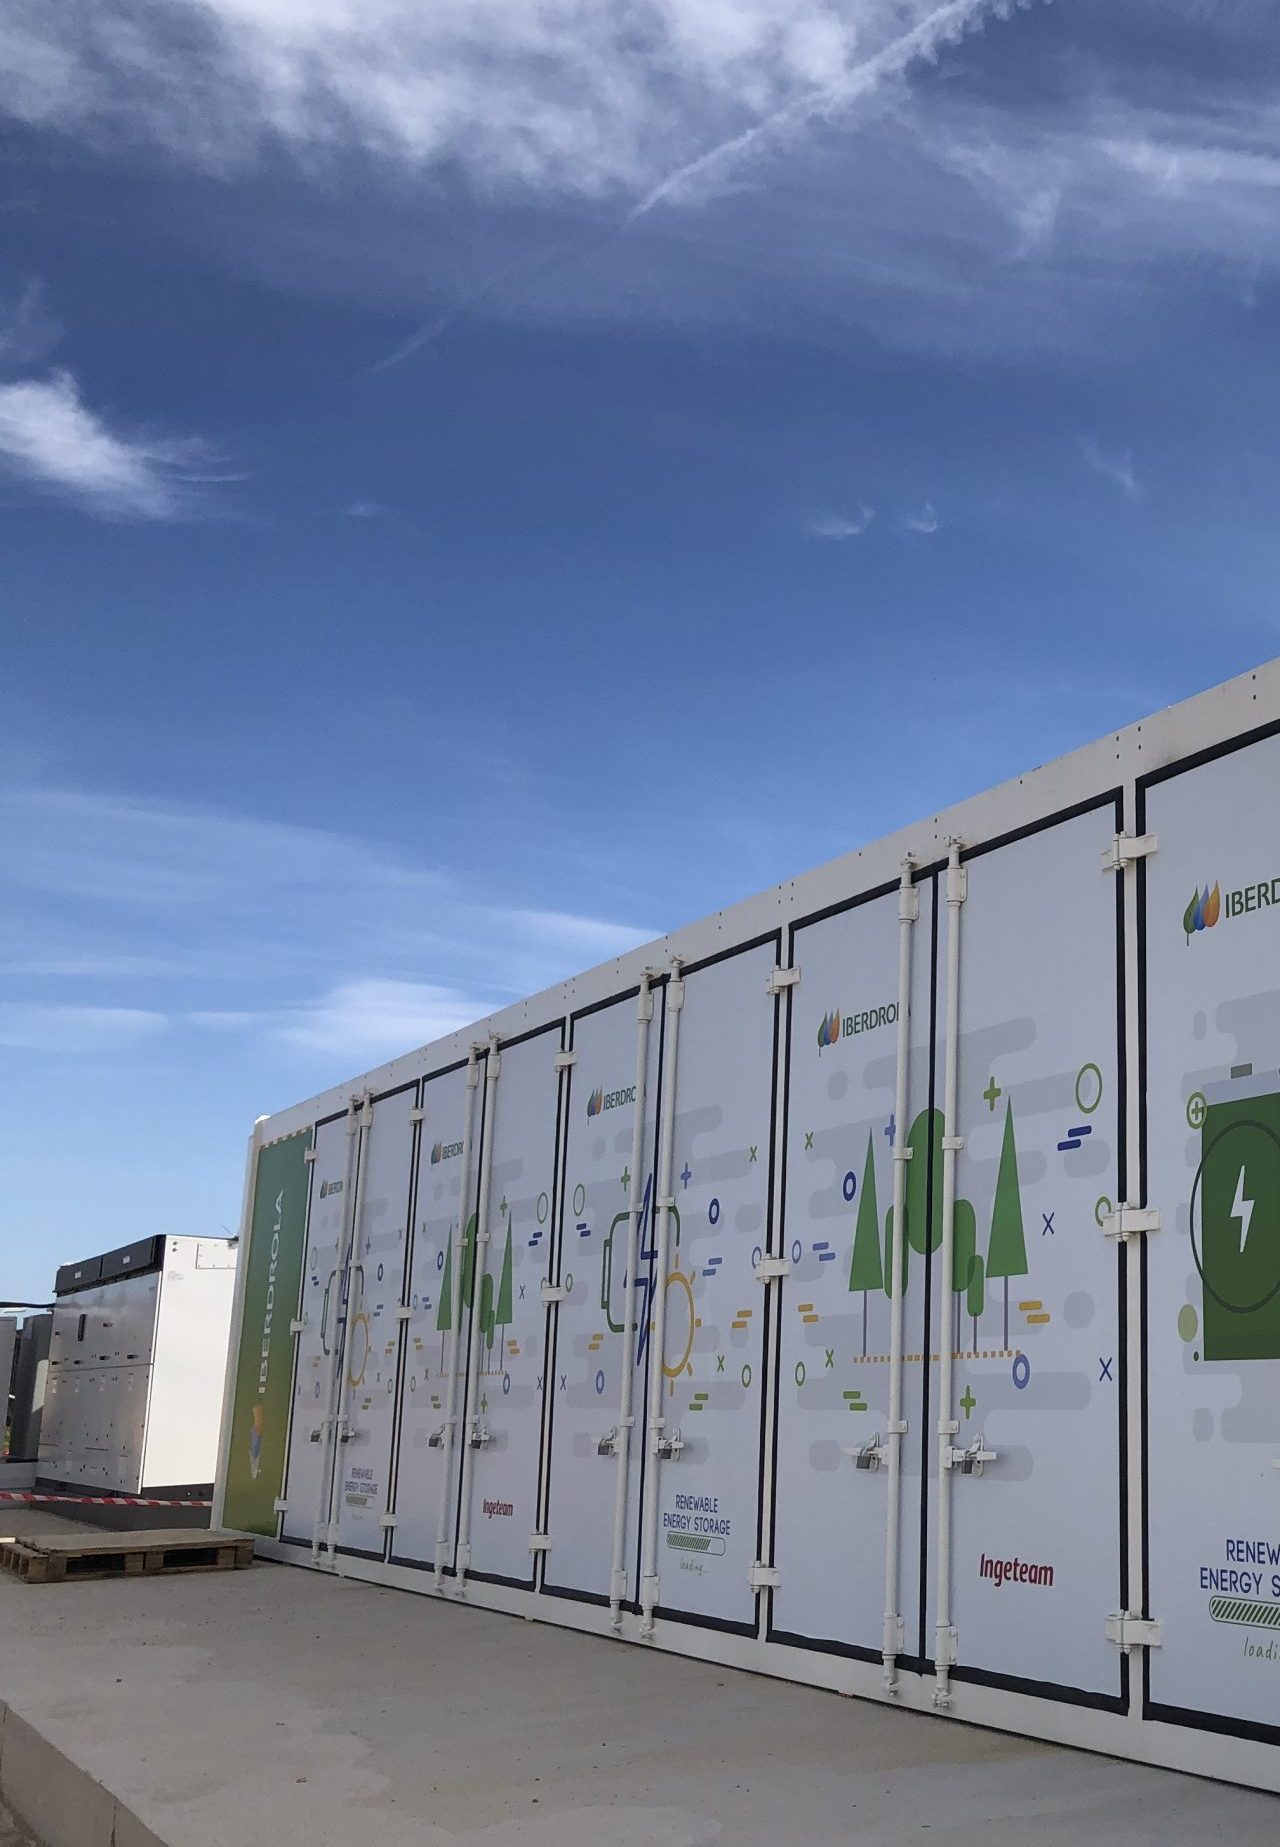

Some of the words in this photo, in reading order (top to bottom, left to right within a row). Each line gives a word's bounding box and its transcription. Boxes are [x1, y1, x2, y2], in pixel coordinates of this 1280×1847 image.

[258, 1189, 284, 1394] IBERDROLA
[483, 1499, 513, 1519] Ingeteam
[676, 1494, 718, 1513] RENEWABLE
[663, 1513, 691, 1530] ENERGY
[694, 1517, 730, 1535] STORAGE
[980, 1553, 1054, 1587] Ingeteam
[1200, 1567, 1263, 1595] ENERGY
